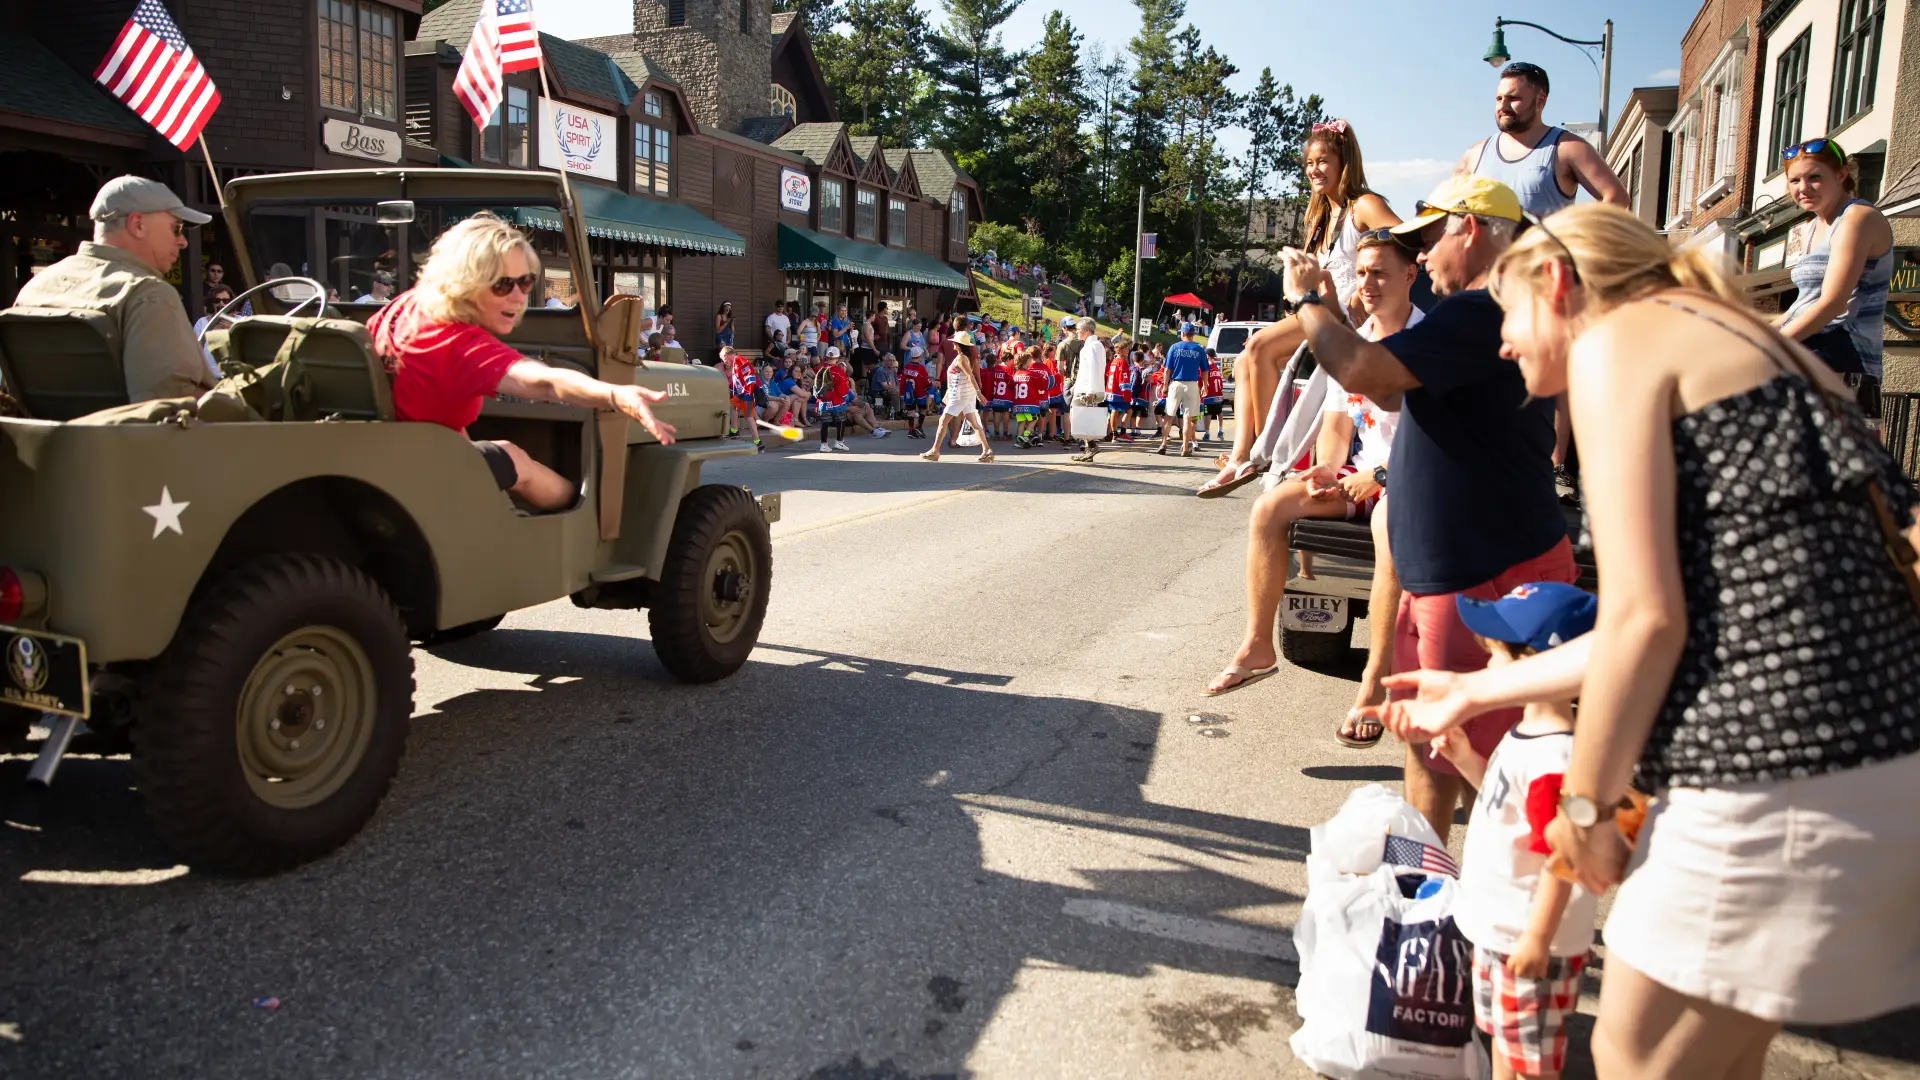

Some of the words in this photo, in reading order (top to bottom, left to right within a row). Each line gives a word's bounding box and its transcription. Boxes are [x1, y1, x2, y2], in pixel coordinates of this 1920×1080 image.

[568, 114, 589, 130] USA
[341, 126, 386, 153] Bass
[566, 132, 591, 147] SPIRIT
[567, 160, 591, 171] SHOP
[667, 383, 689, 397] U.S.A.
[1015, 383, 1029, 399] 18
[1289, 597, 1342, 613] RILEY
[1302, 610, 1327, 621] Ford
